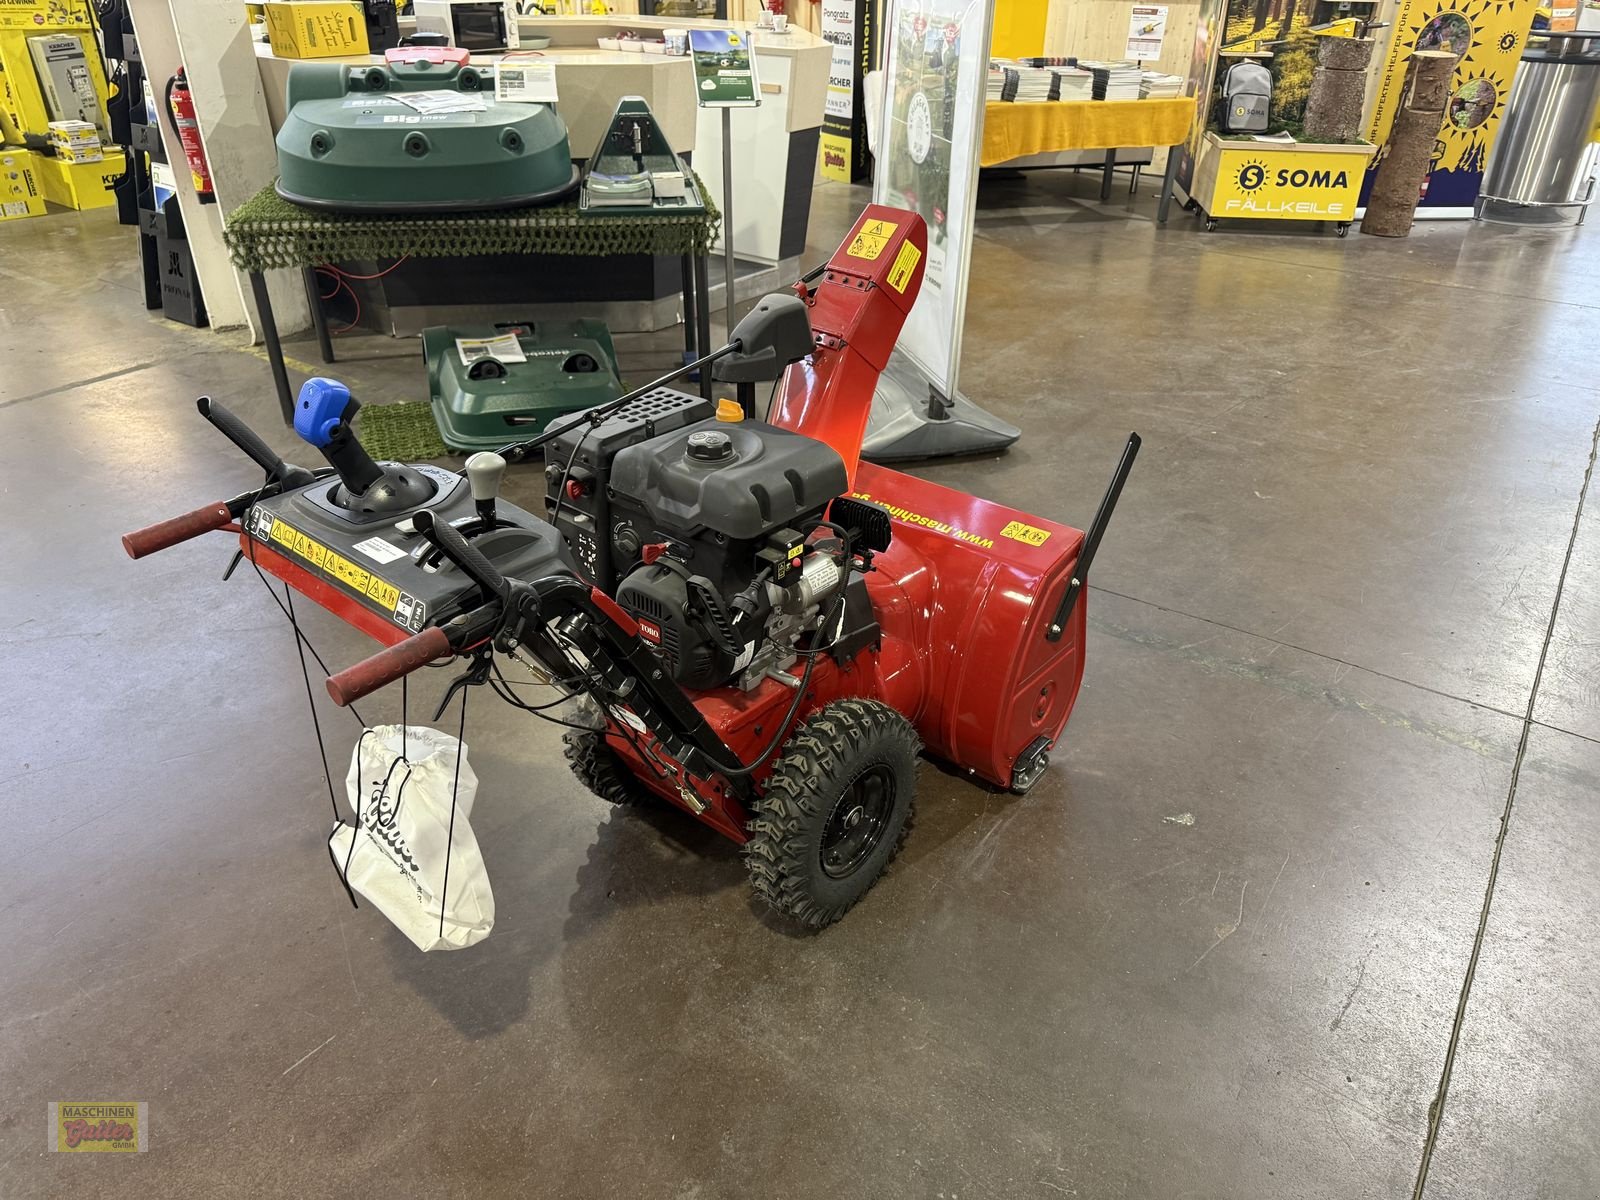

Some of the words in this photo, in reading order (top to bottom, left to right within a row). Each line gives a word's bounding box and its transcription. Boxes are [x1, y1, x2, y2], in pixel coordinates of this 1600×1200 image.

[823, 8, 849, 21] Pongratz
[1373, 75, 1392, 128] PERFEKTER
[1386, 34, 1402, 72] HELFER
[1398, 12, 1409, 32] FÜR
[829, 77, 851, 88] RCHER
[1275, 168, 1348, 189] SOMA
[1225, 197, 1344, 215] FÄLLKEILE
[640, 623, 659, 638] TORO
